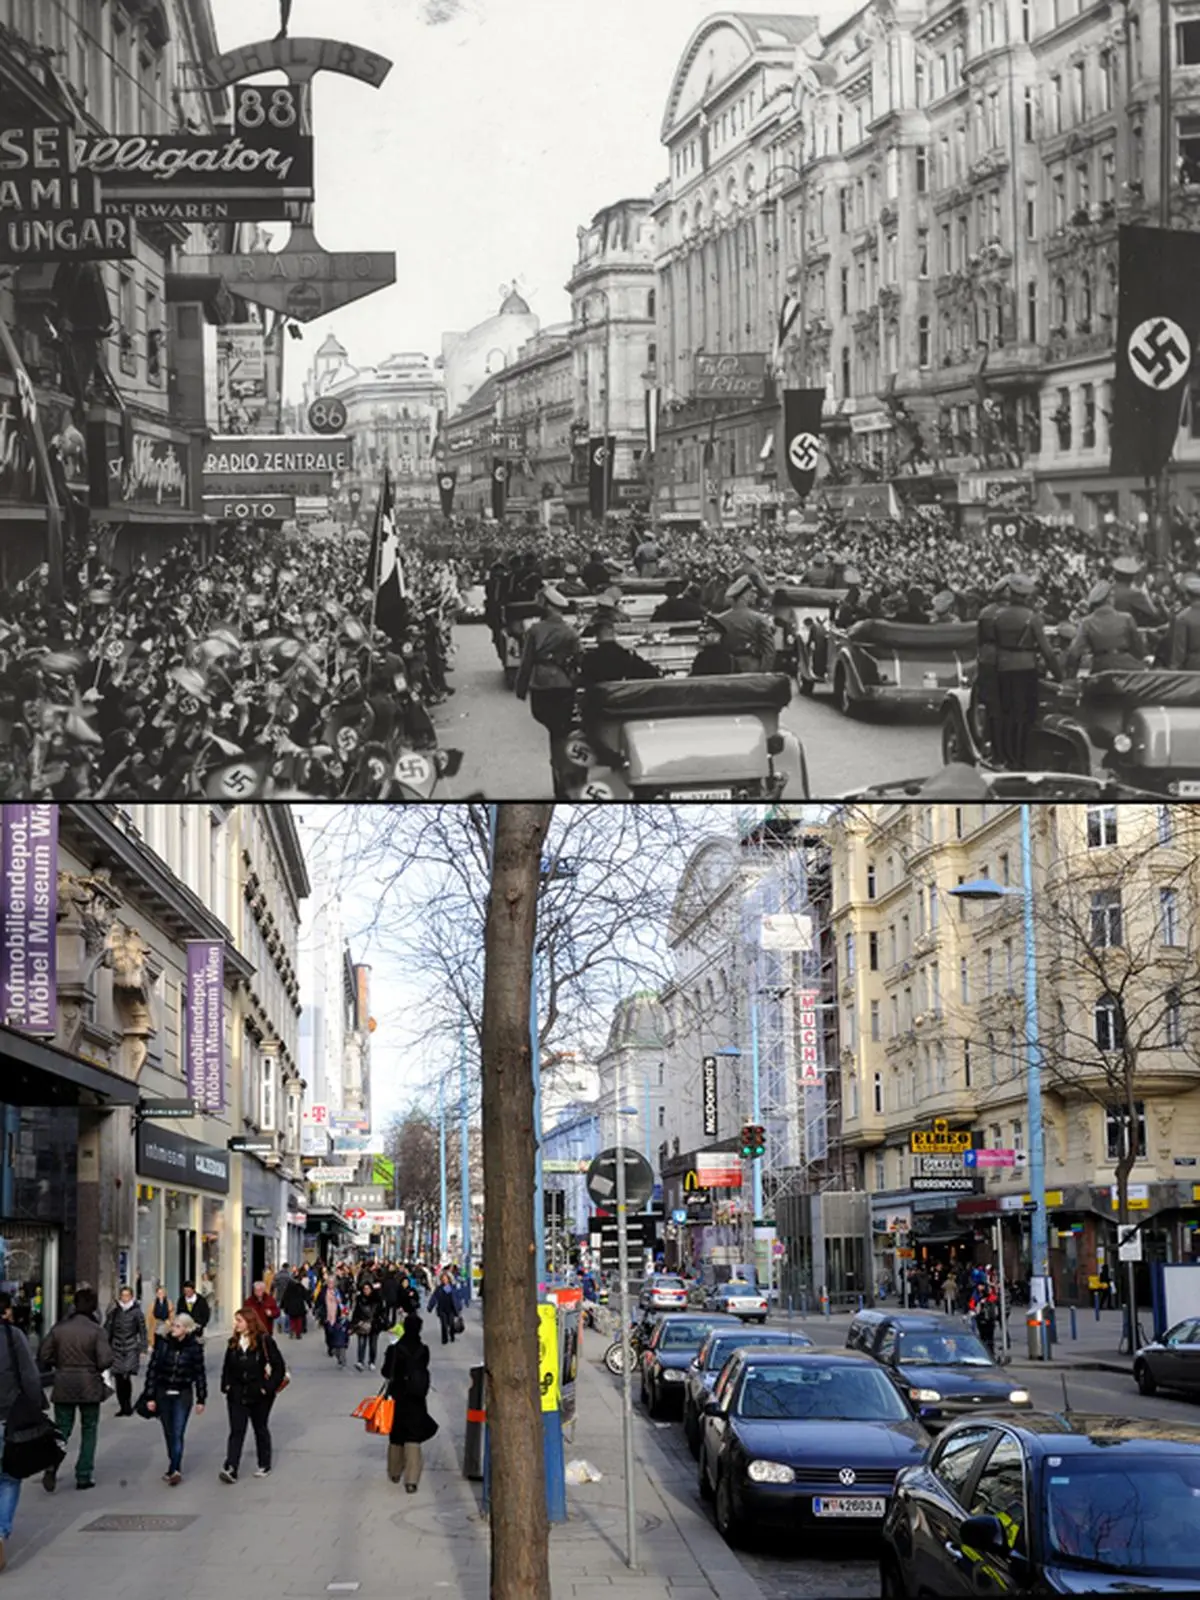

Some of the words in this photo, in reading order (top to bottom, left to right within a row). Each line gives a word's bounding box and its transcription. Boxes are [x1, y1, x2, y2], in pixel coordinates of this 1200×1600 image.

[238, 88, 297, 128] 88
[8, 219, 126, 252] UNGAR
[313, 403, 343, 427] 86
[207, 453, 258, 471] RADIO
[264, 452, 345, 470] ZENTRALE
[224, 503, 275, 518] FOTO
[29, 845, 49, 943] Museum
[206, 947, 219, 983] Wien
[29, 952, 49, 1024] Möbel
[206, 987, 219, 1053] Museum
[802, 997, 815, 1078] MUCHA
[206, 1058, 219, 1106] Möbel
